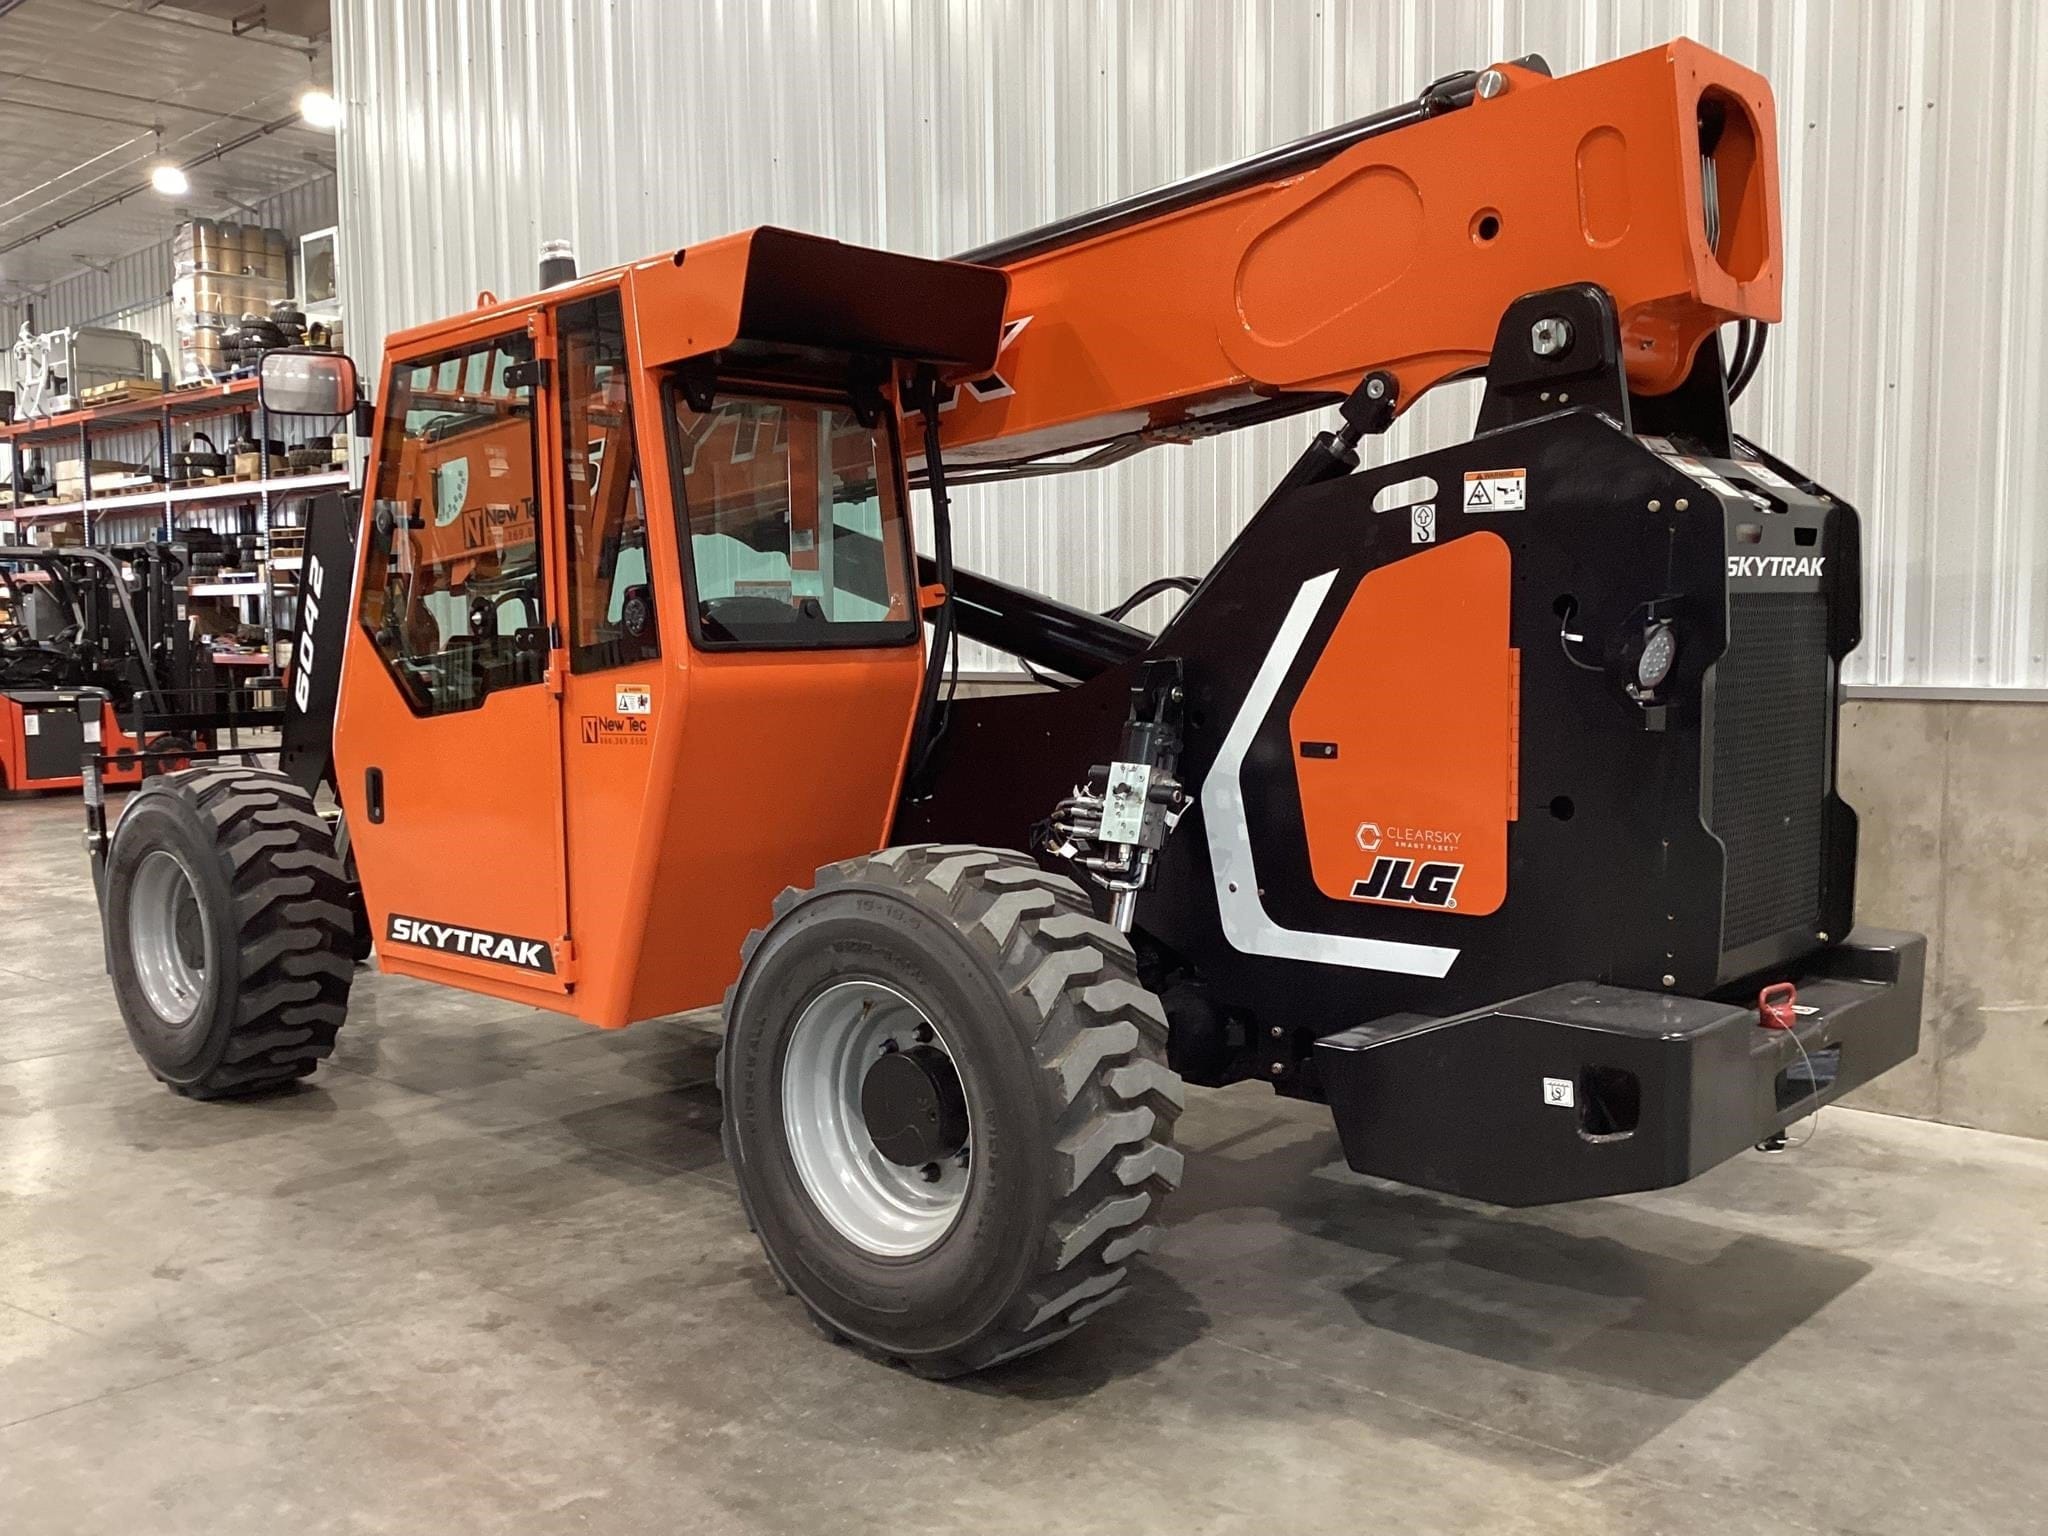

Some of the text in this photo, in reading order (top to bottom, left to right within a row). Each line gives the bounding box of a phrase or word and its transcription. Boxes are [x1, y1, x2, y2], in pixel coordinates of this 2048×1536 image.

[486, 497, 536, 527] New Te
[1727, 556, 1826, 577] SKYTRAK
[295, 555, 324, 713] 6042
[599, 716, 647, 732] New Tec
[1386, 826, 1462, 844] CLEARSKY
[1395, 841, 1424, 849] SMART
[391, 918, 545, 967] SKYTRAK
